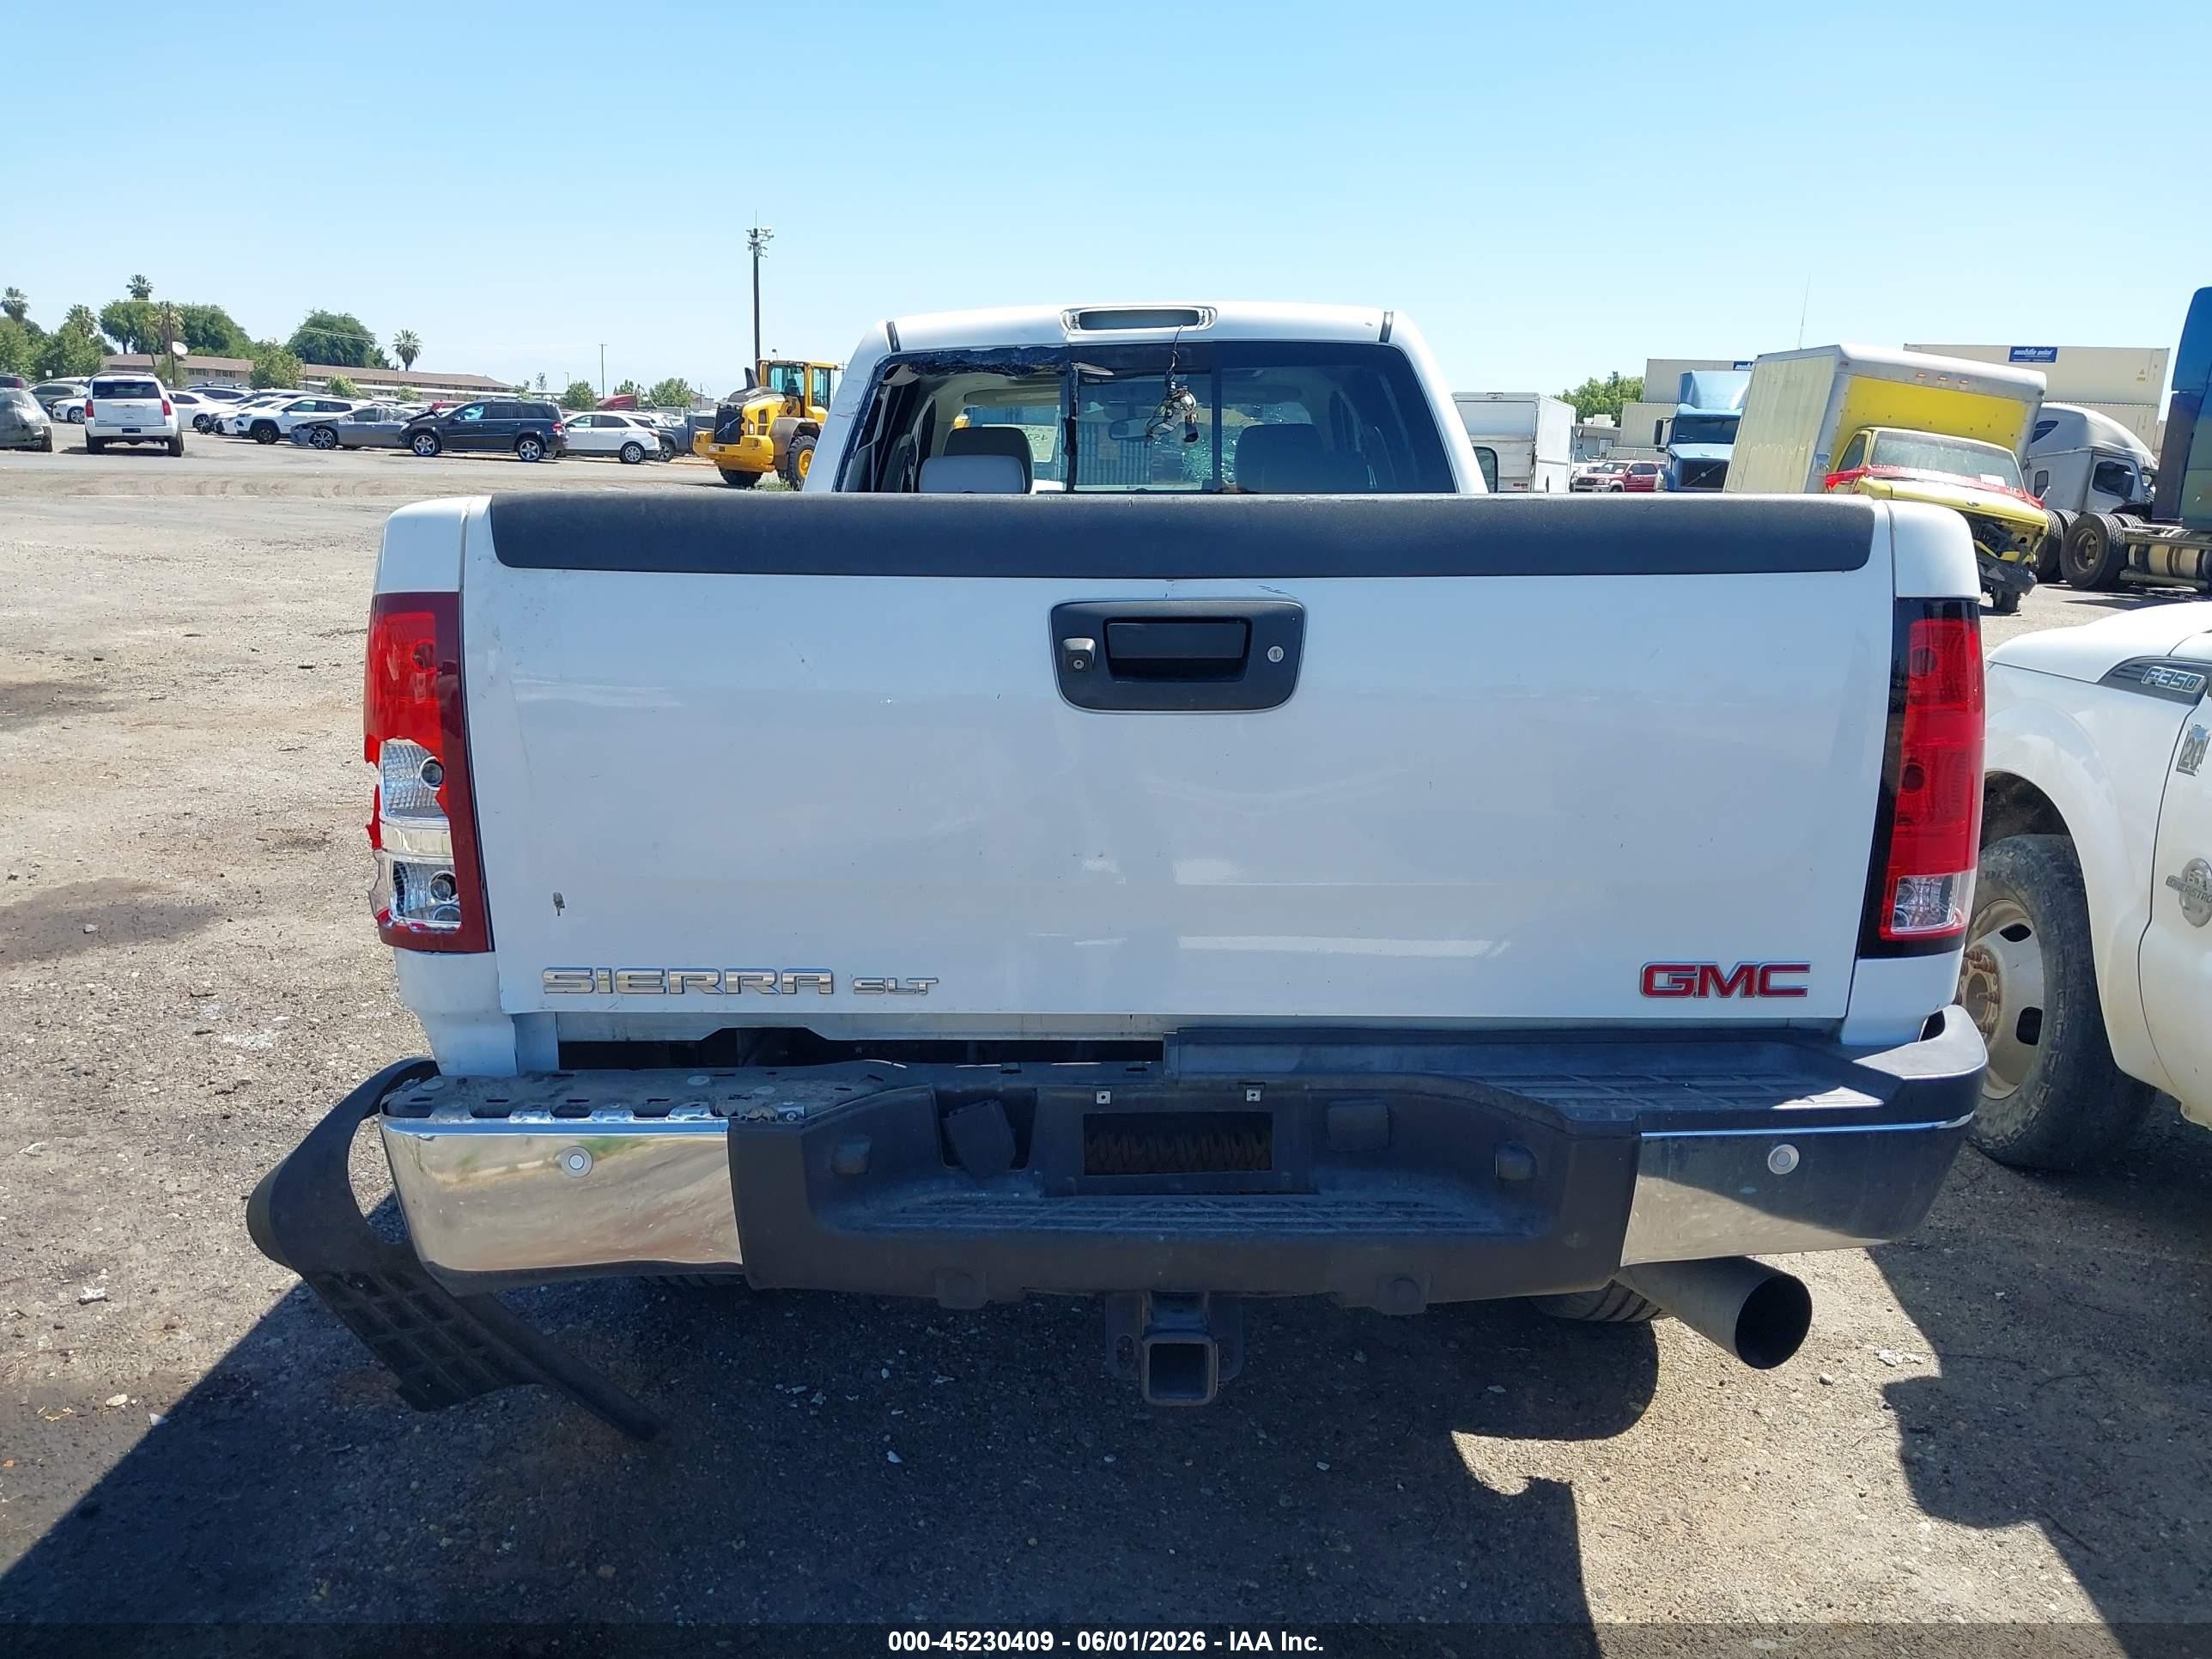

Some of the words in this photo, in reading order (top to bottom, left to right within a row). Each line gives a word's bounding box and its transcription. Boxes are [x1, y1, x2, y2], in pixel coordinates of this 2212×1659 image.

[542, 968, 835, 995] SIERRA
[853, 976, 939, 995] SLT
[1639, 961, 1811, 998] GMC
